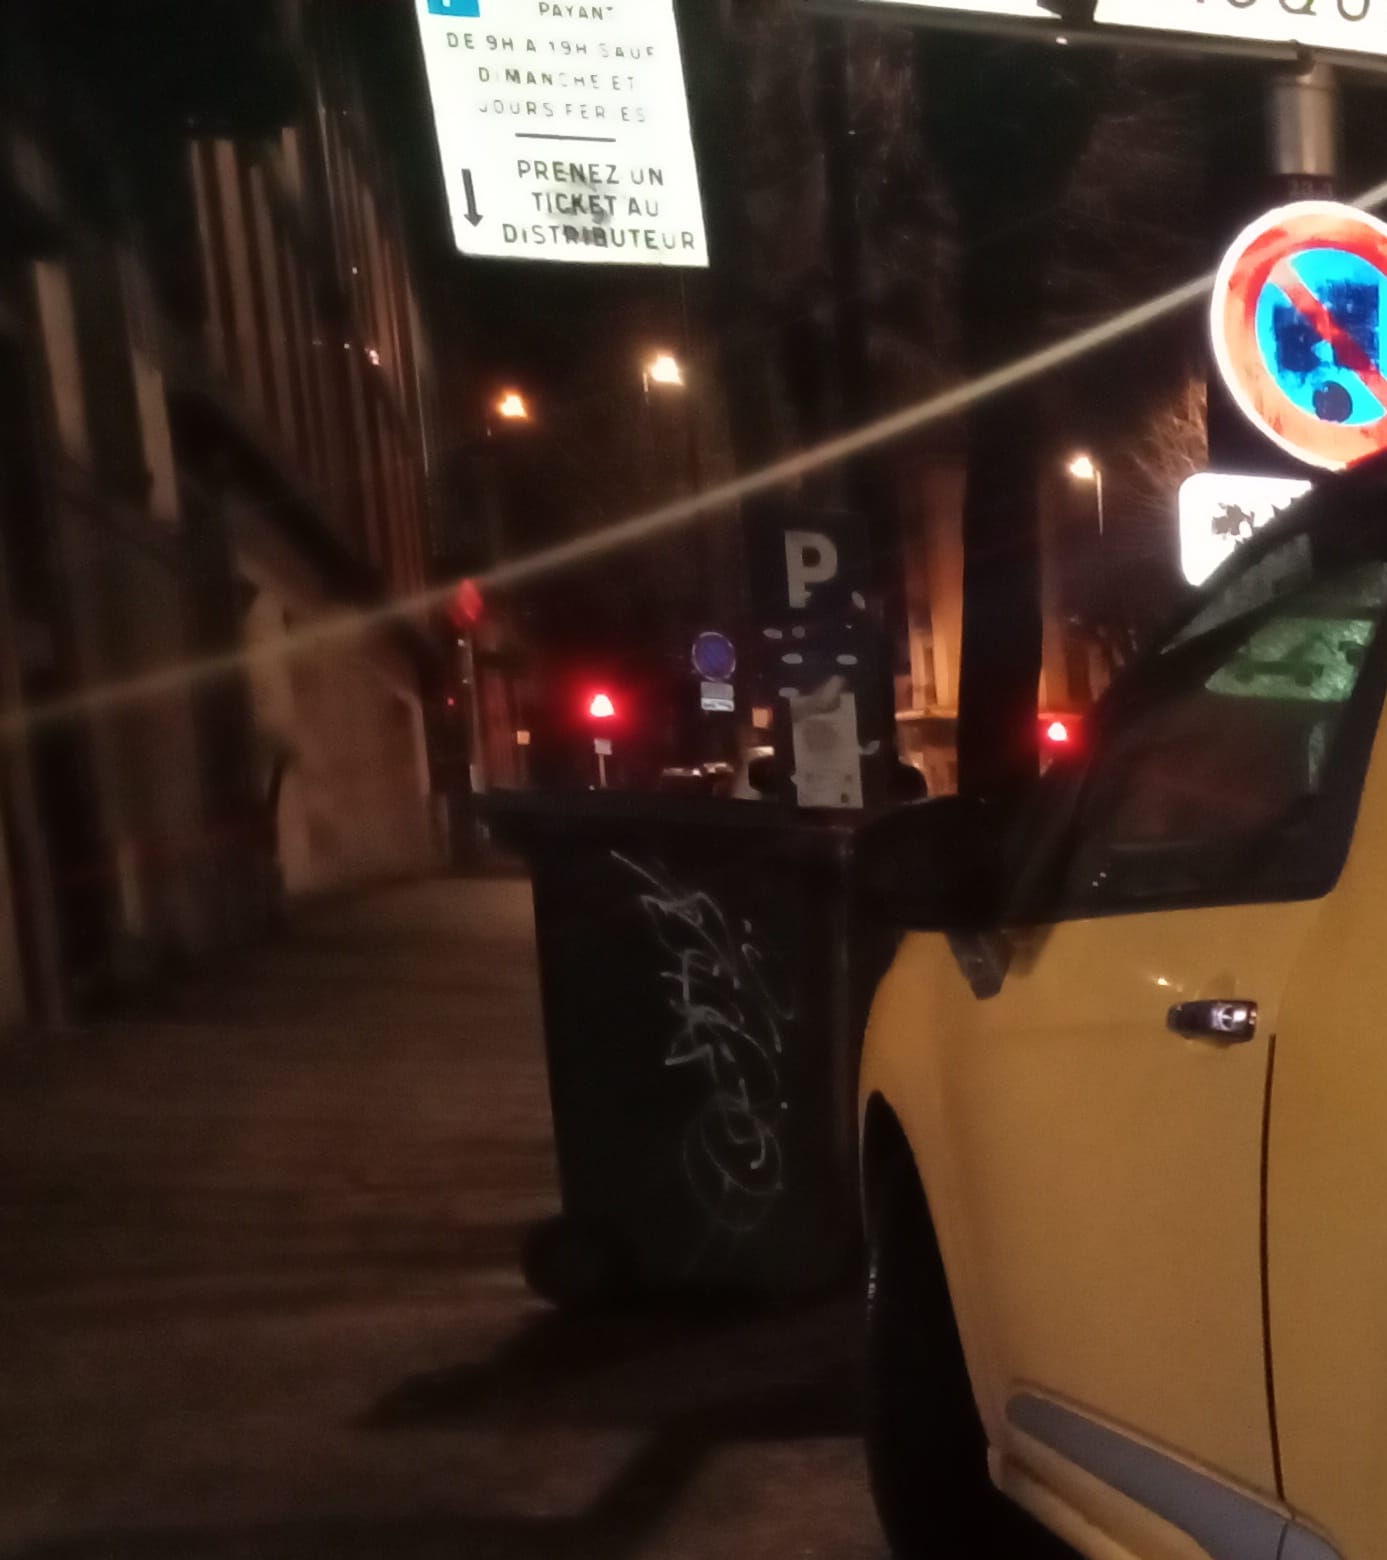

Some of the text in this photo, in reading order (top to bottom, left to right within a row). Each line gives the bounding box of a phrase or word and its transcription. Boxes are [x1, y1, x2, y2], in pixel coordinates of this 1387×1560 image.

[446, 32, 476, 50] DE
[486, 34, 514, 52] 9H
[548, 40, 588, 56] 19H
[477, 66, 635, 92] DMANCHE ET
[565, 103, 647, 123] FERES
[517, 159, 665, 186] PRENEZ UN
[532, 191, 660, 217] TICKET AU
[502, 223, 696, 250] DISTRIBUTEUR
[784, 529, 839, 609] P
